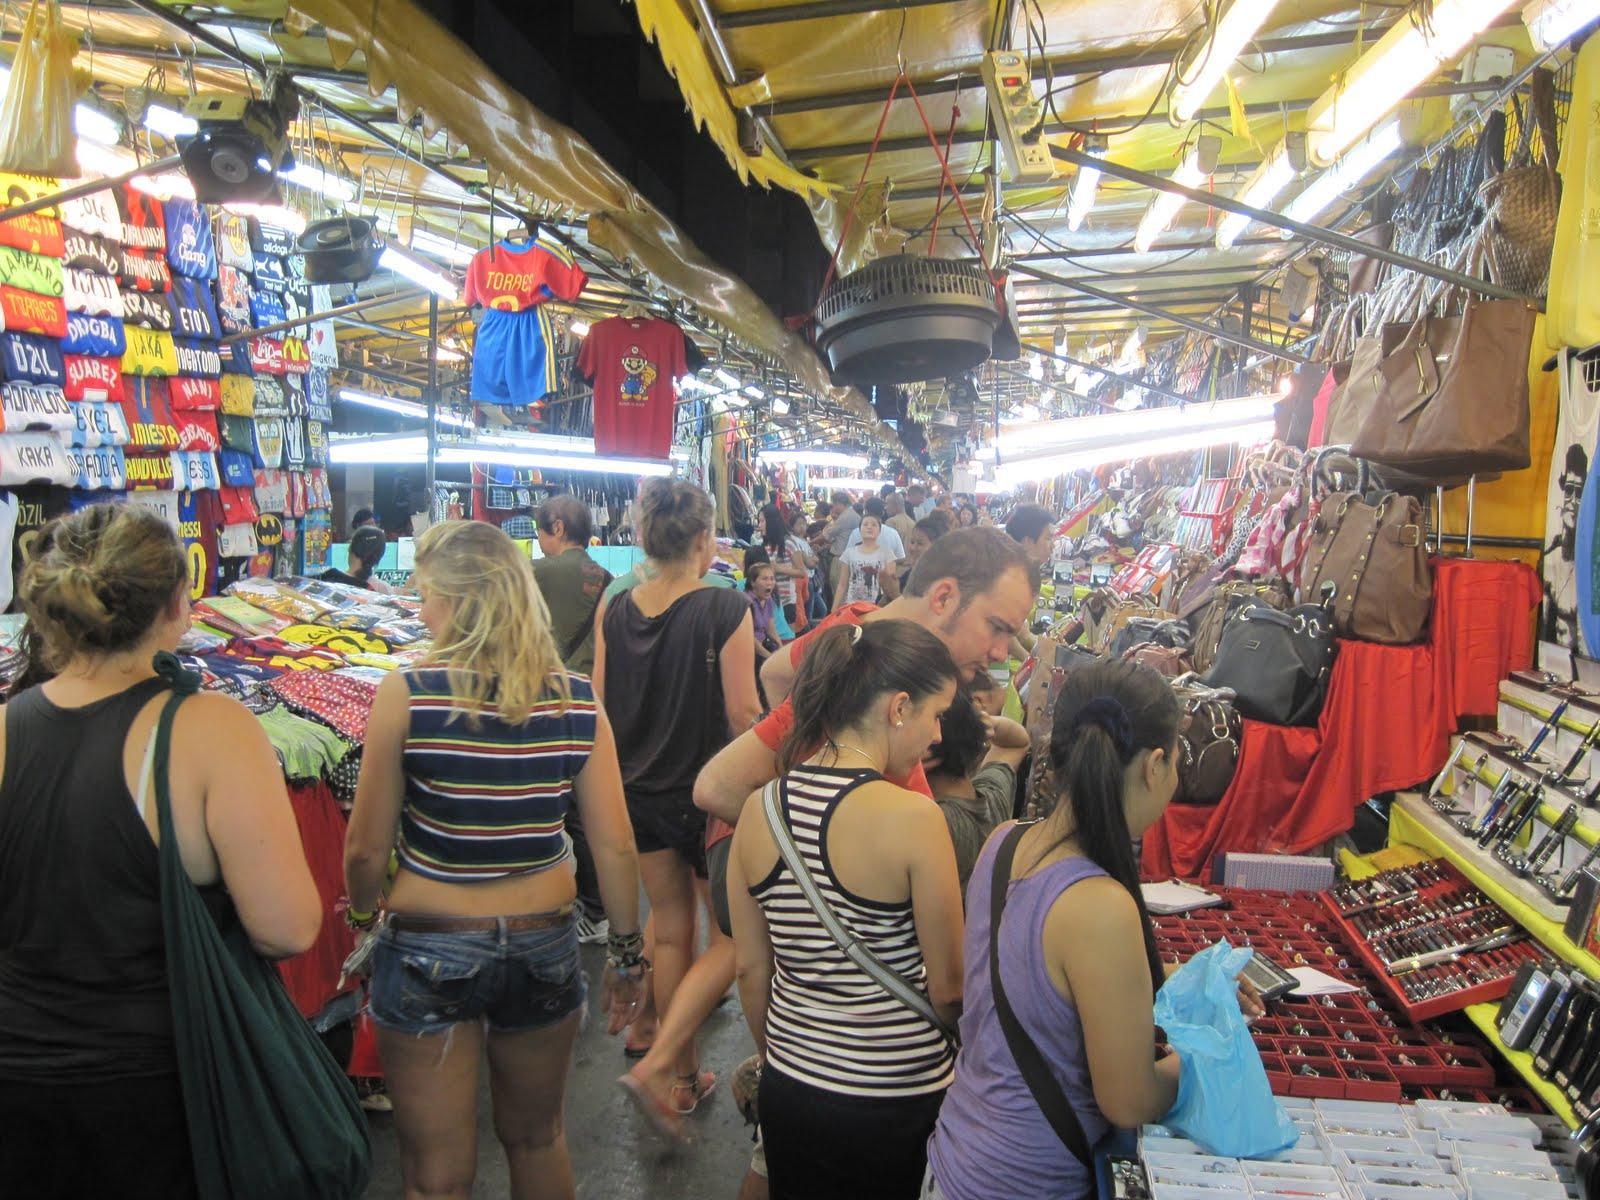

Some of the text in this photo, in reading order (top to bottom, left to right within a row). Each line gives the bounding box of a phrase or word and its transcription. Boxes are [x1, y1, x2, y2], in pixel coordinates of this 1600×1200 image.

[69, 359, 118, 388] SUAREZ
[182, 379, 212, 401] NANI
[70, 405, 118, 434] EVEZ
